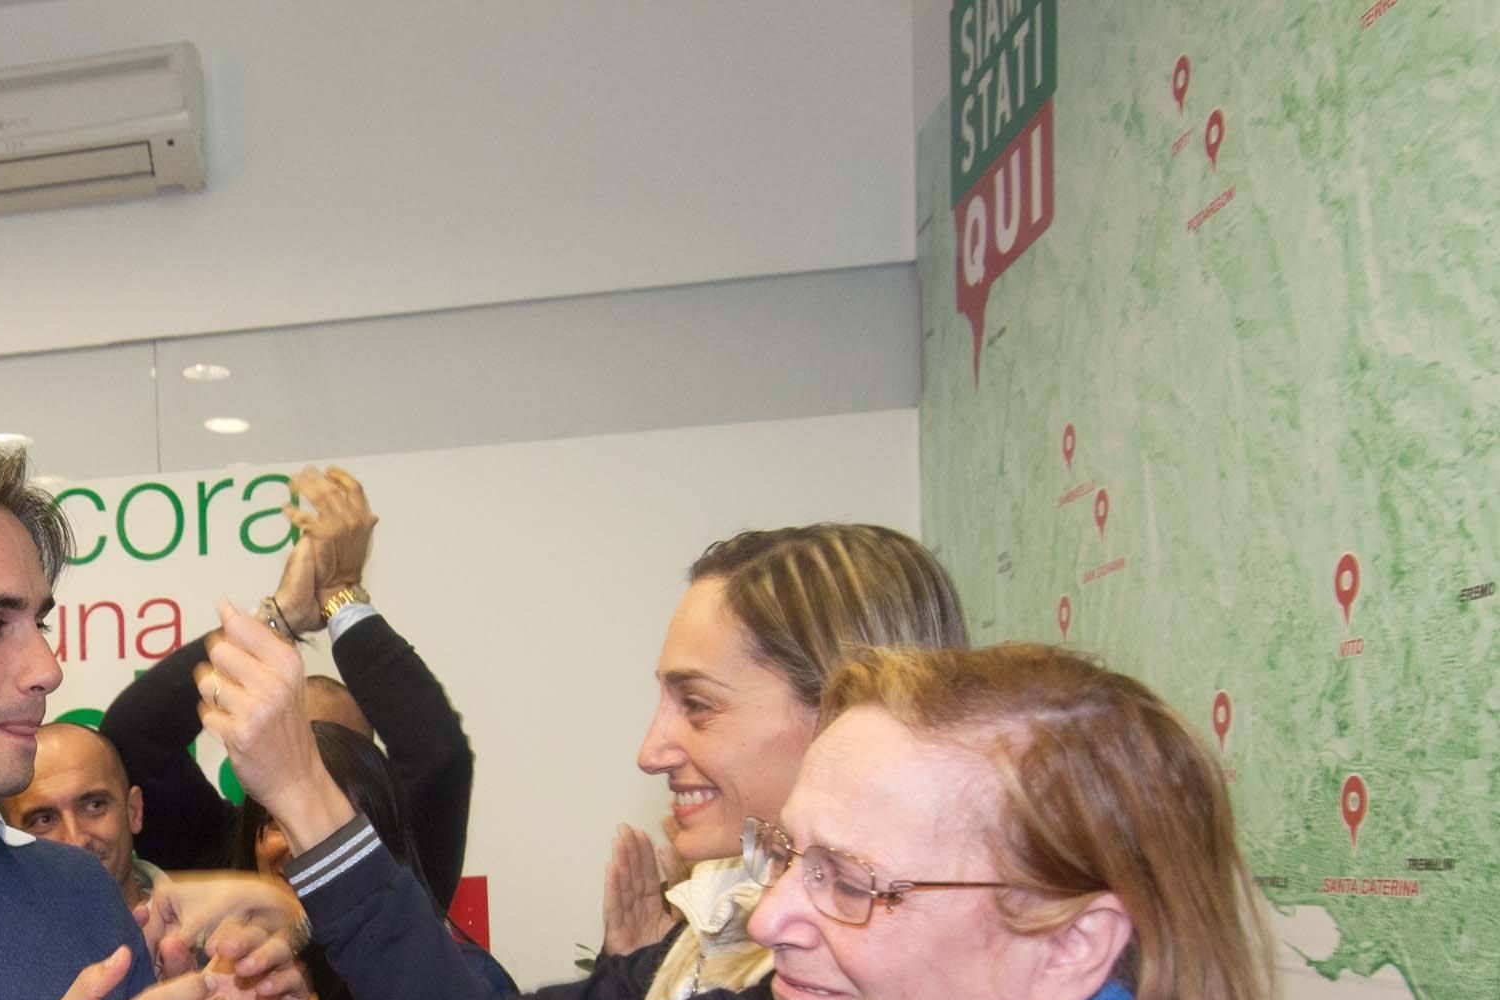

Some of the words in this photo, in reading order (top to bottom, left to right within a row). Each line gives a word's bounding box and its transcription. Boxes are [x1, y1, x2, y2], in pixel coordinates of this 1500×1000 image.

[961, 1, 1043, 173] STATI
[964, 124, 1043, 287] QUI
[53, 474, 300, 566] cora
[1323, 878, 1357, 893] SANTA
[1361, 879, 1419, 896] CATERINA
